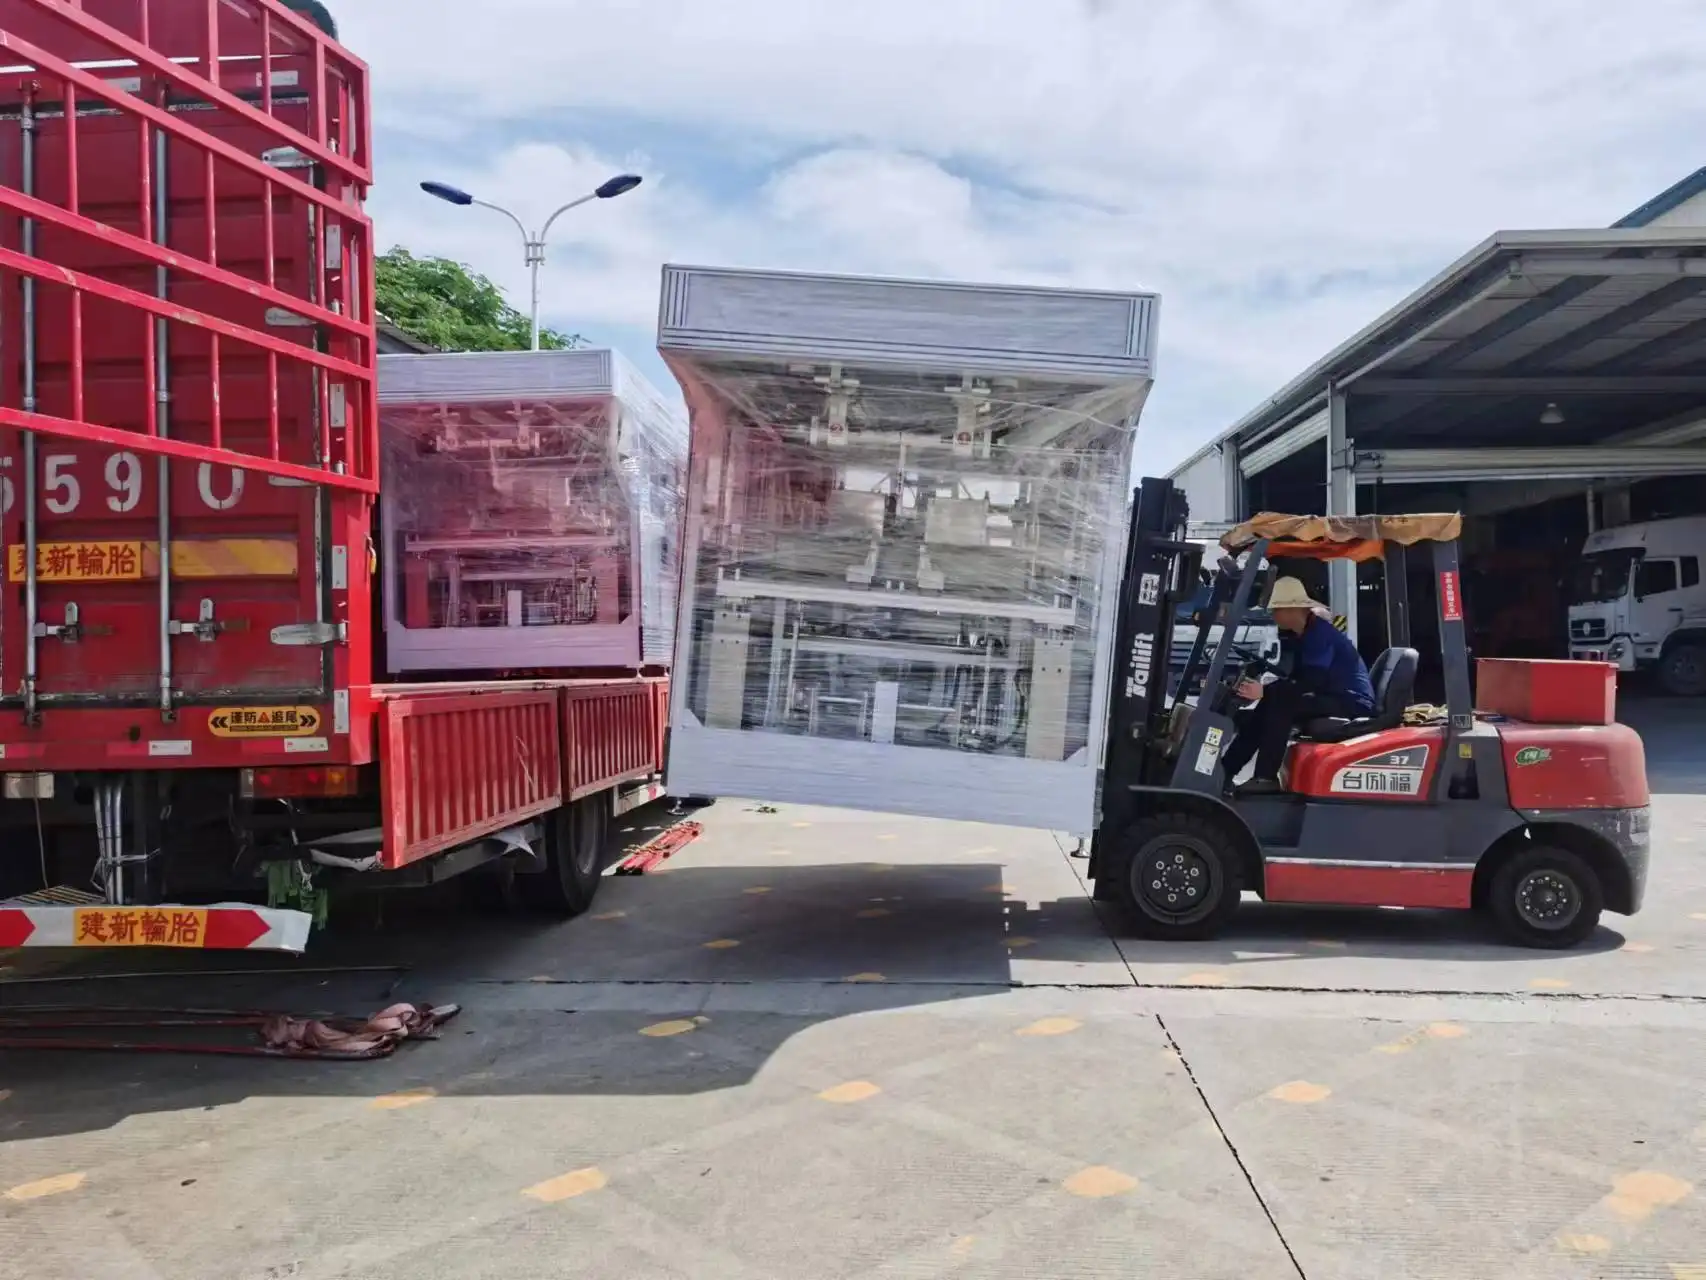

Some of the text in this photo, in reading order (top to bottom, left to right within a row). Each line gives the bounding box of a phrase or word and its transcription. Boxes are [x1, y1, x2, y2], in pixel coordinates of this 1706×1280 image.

[1125, 632, 1155, 698] Tailift
[1342, 771, 1412, 792] 台励福
[78, 911, 200, 943] 建新輪胎
